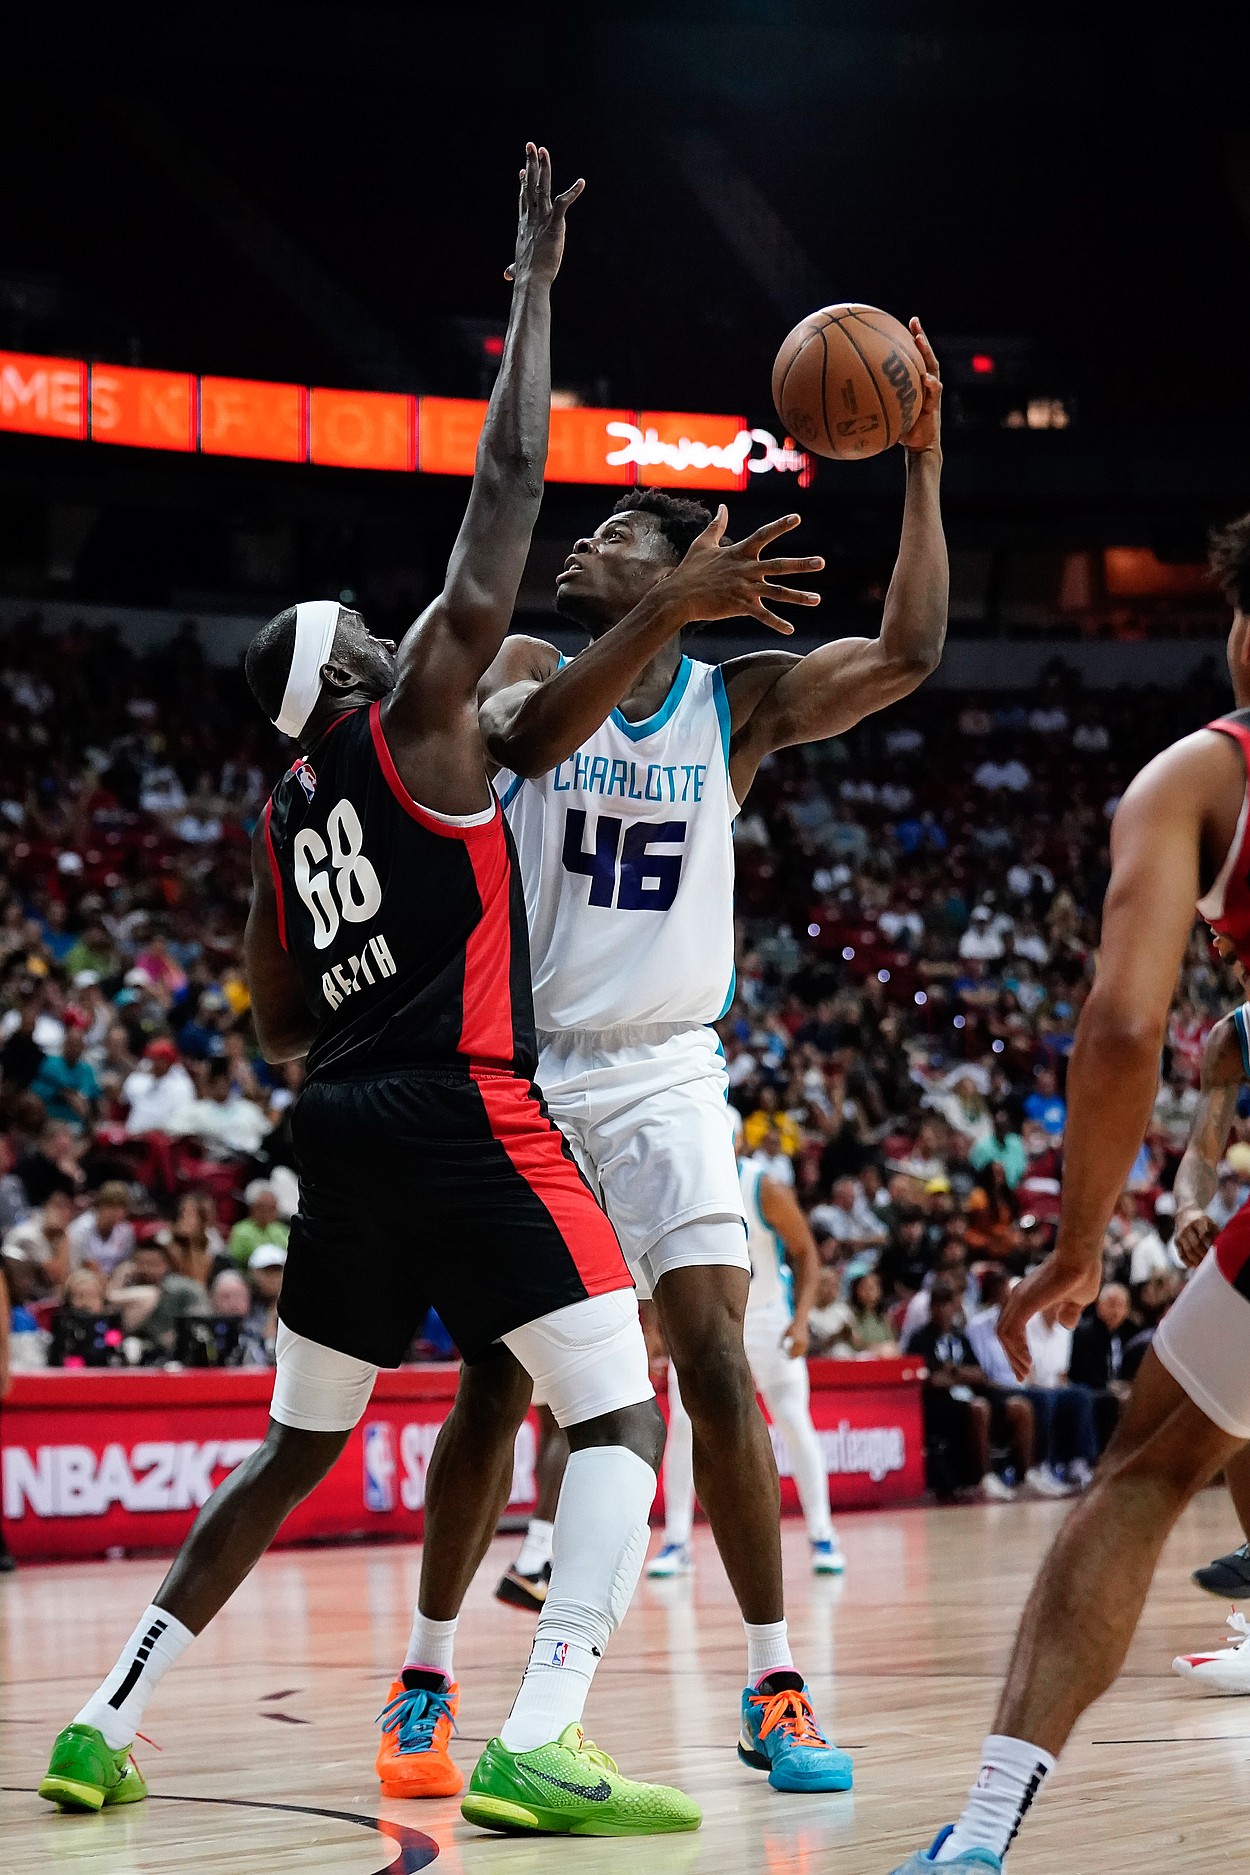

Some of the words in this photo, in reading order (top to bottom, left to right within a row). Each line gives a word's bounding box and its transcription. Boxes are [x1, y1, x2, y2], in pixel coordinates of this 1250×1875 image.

[553, 751, 708, 803] CHARLOTTE
[294, 798, 383, 950] 68
[561, 807, 687, 912] 46
